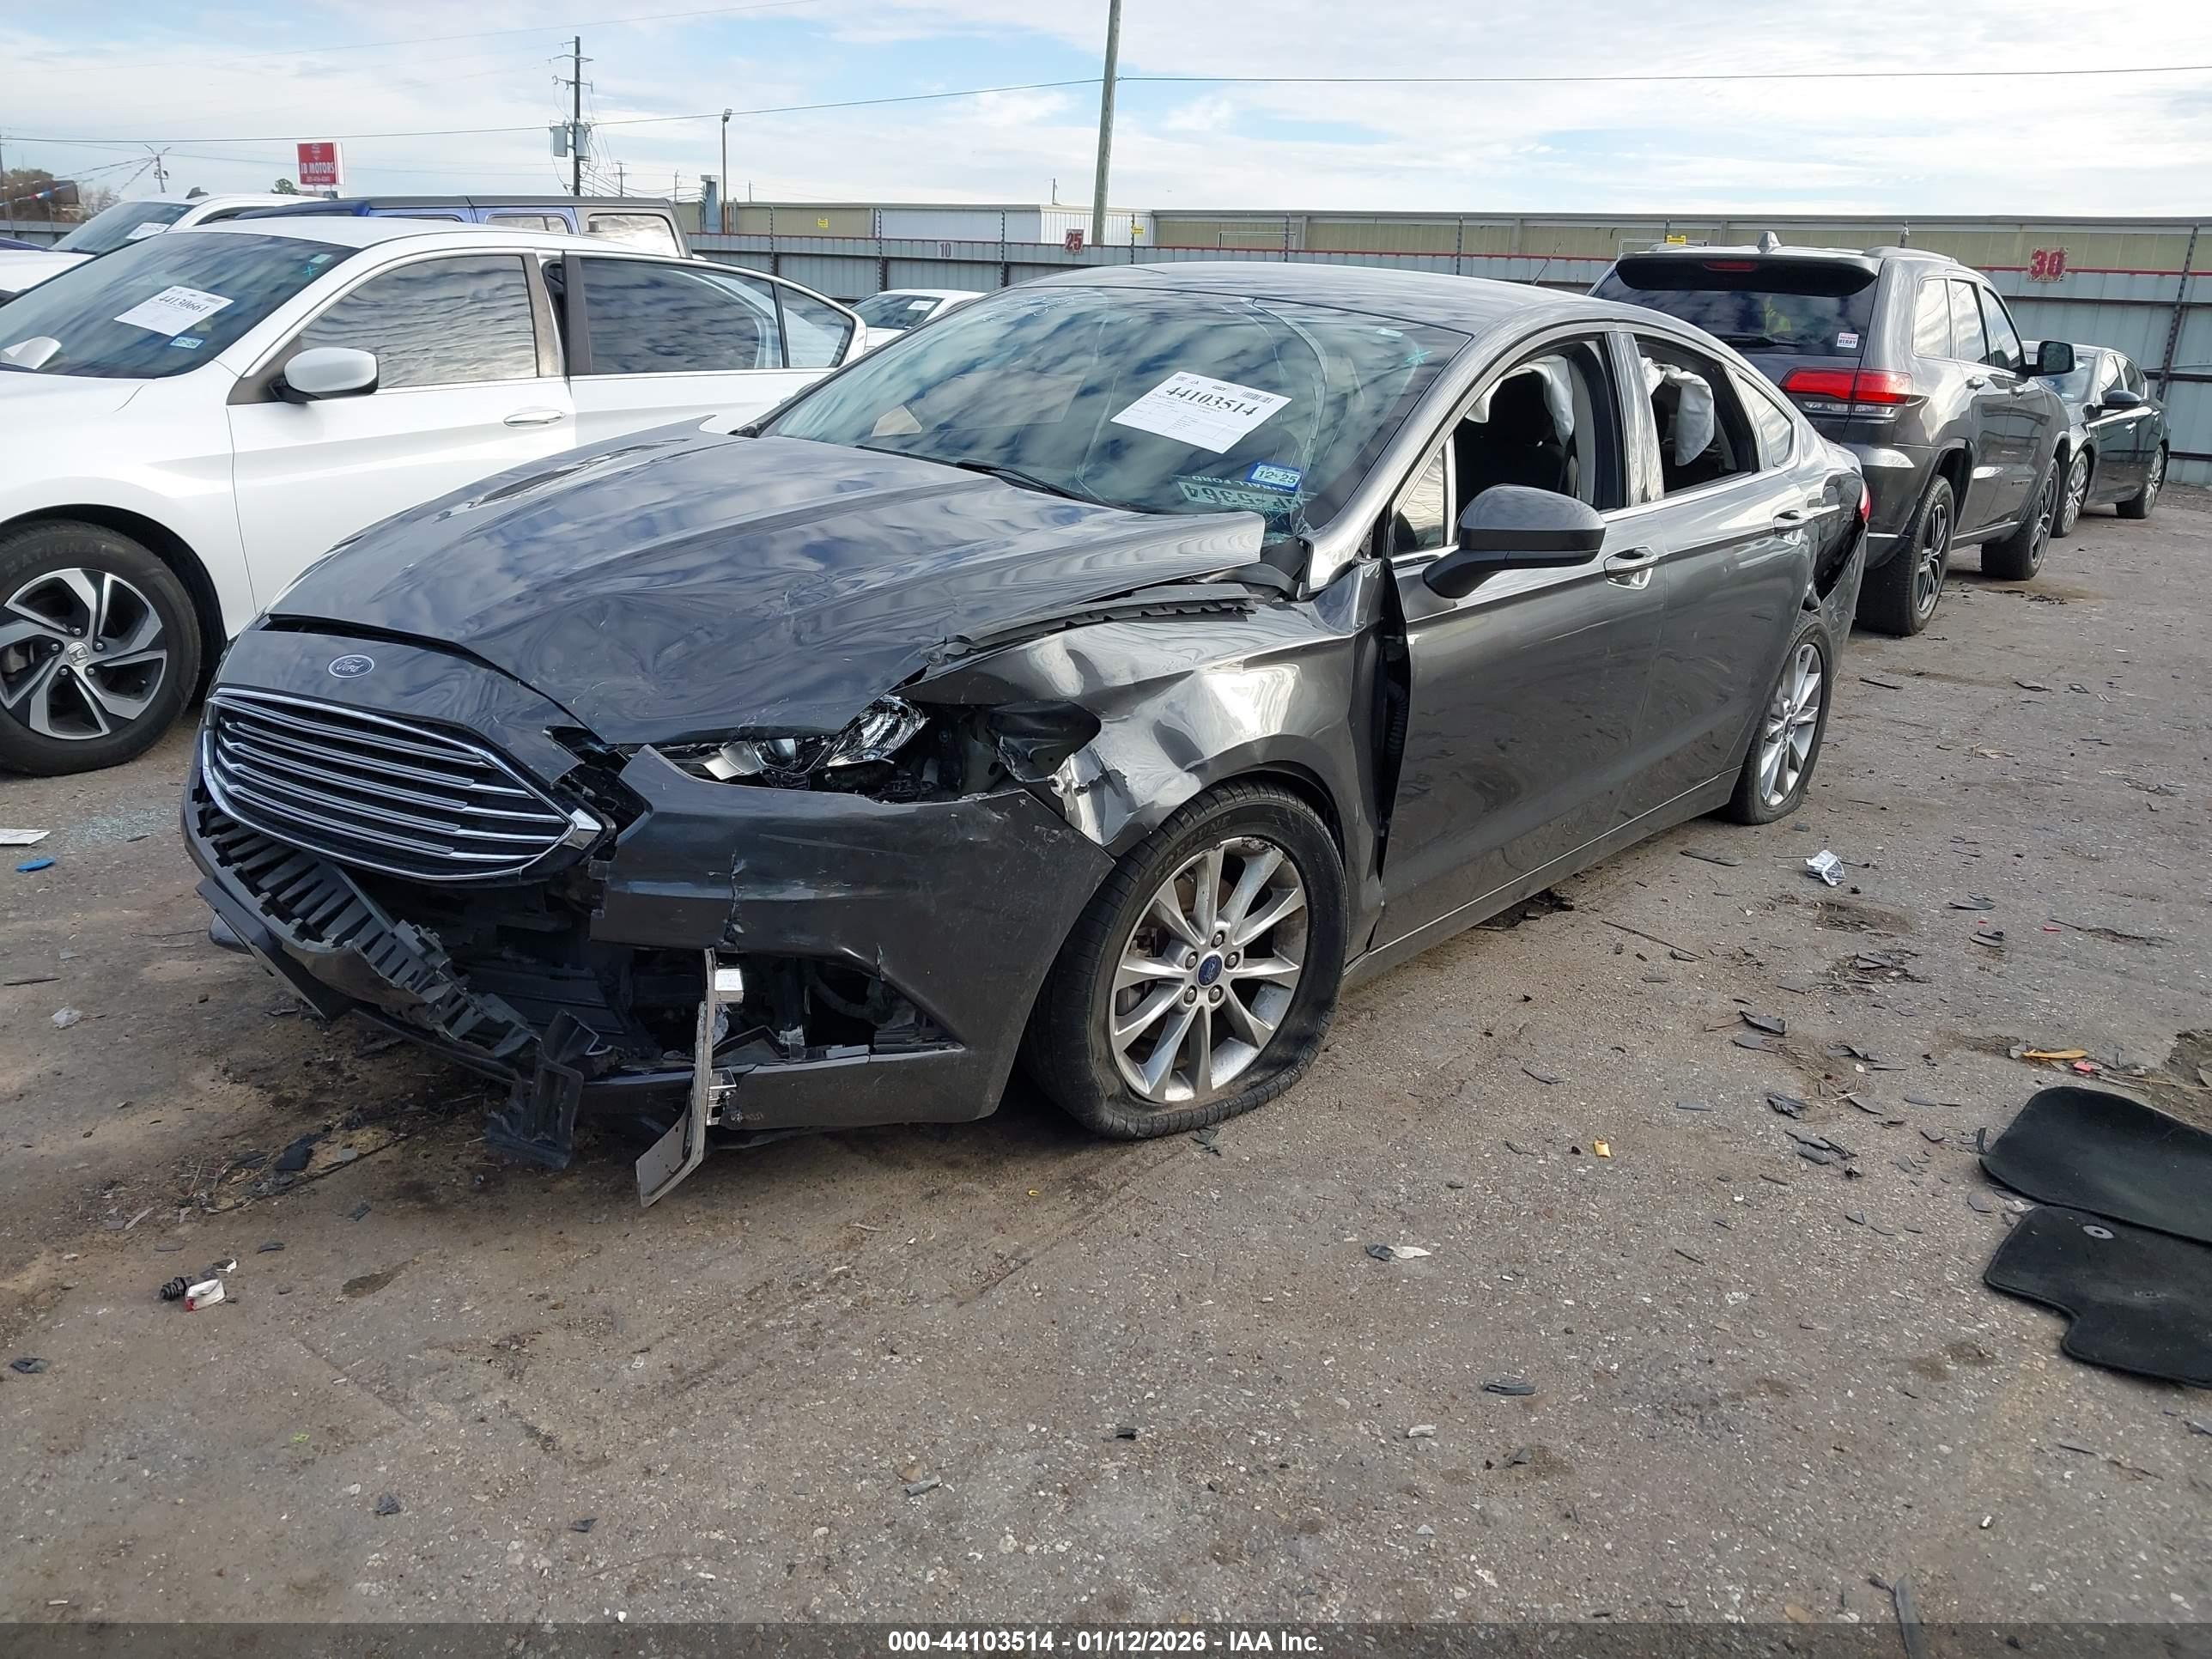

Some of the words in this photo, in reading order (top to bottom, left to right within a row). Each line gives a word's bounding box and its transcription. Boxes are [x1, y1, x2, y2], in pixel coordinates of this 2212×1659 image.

[309, 161, 335, 174] MOTORS
[939, 242, 951, 258] 10
[1066, 232, 1083, 251] 25
[2031, 250, 2063, 278] 30
[1166, 386, 1259, 416] 44103514
[1192, 475, 1232, 486] FORD
